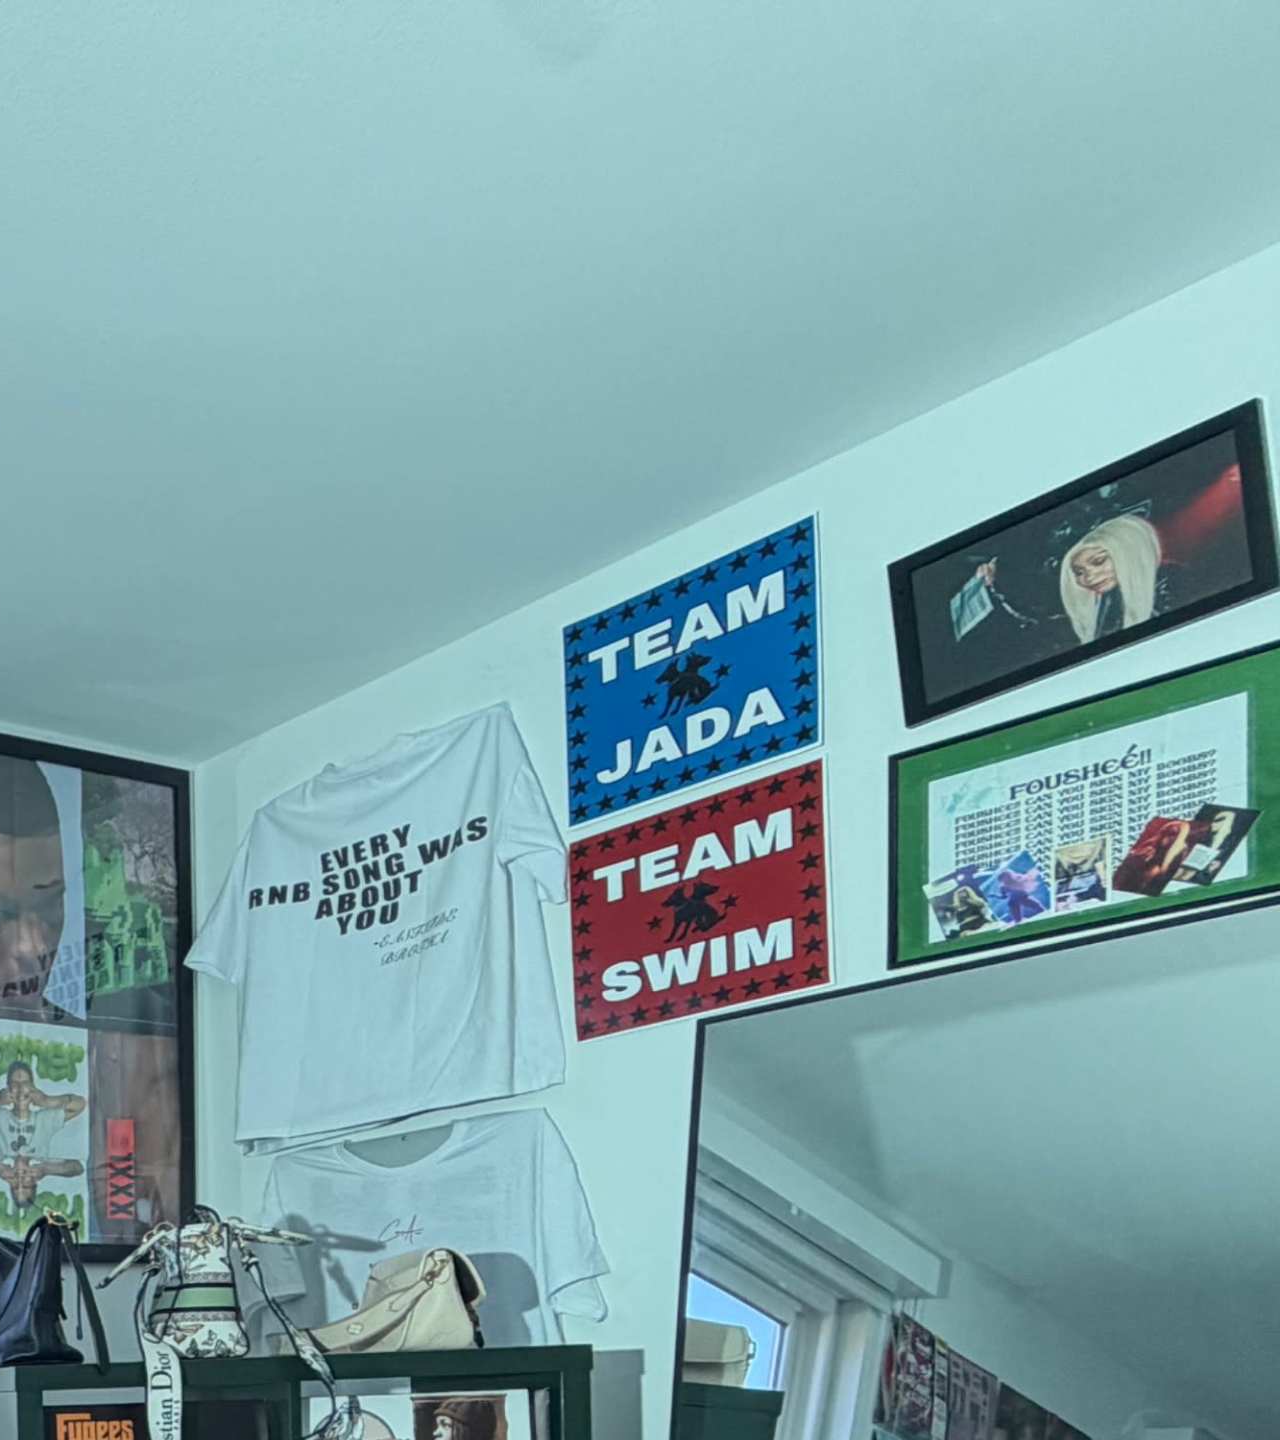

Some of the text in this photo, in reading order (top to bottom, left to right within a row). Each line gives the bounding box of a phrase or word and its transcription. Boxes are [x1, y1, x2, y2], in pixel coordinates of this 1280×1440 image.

[588, 571, 786, 684] TEAM
[596, 687, 786, 784] JADA
[248, 816, 488, 910] RNB SONG WAS
[320, 823, 412, 875] EVERY
[593, 807, 795, 902] TEAM
[314, 869, 423, 920] ABOUT
[336, 901, 400, 936] YOU
[601, 918, 795, 1003] SWIM
[151, 1350, 174, 1392] Dior
